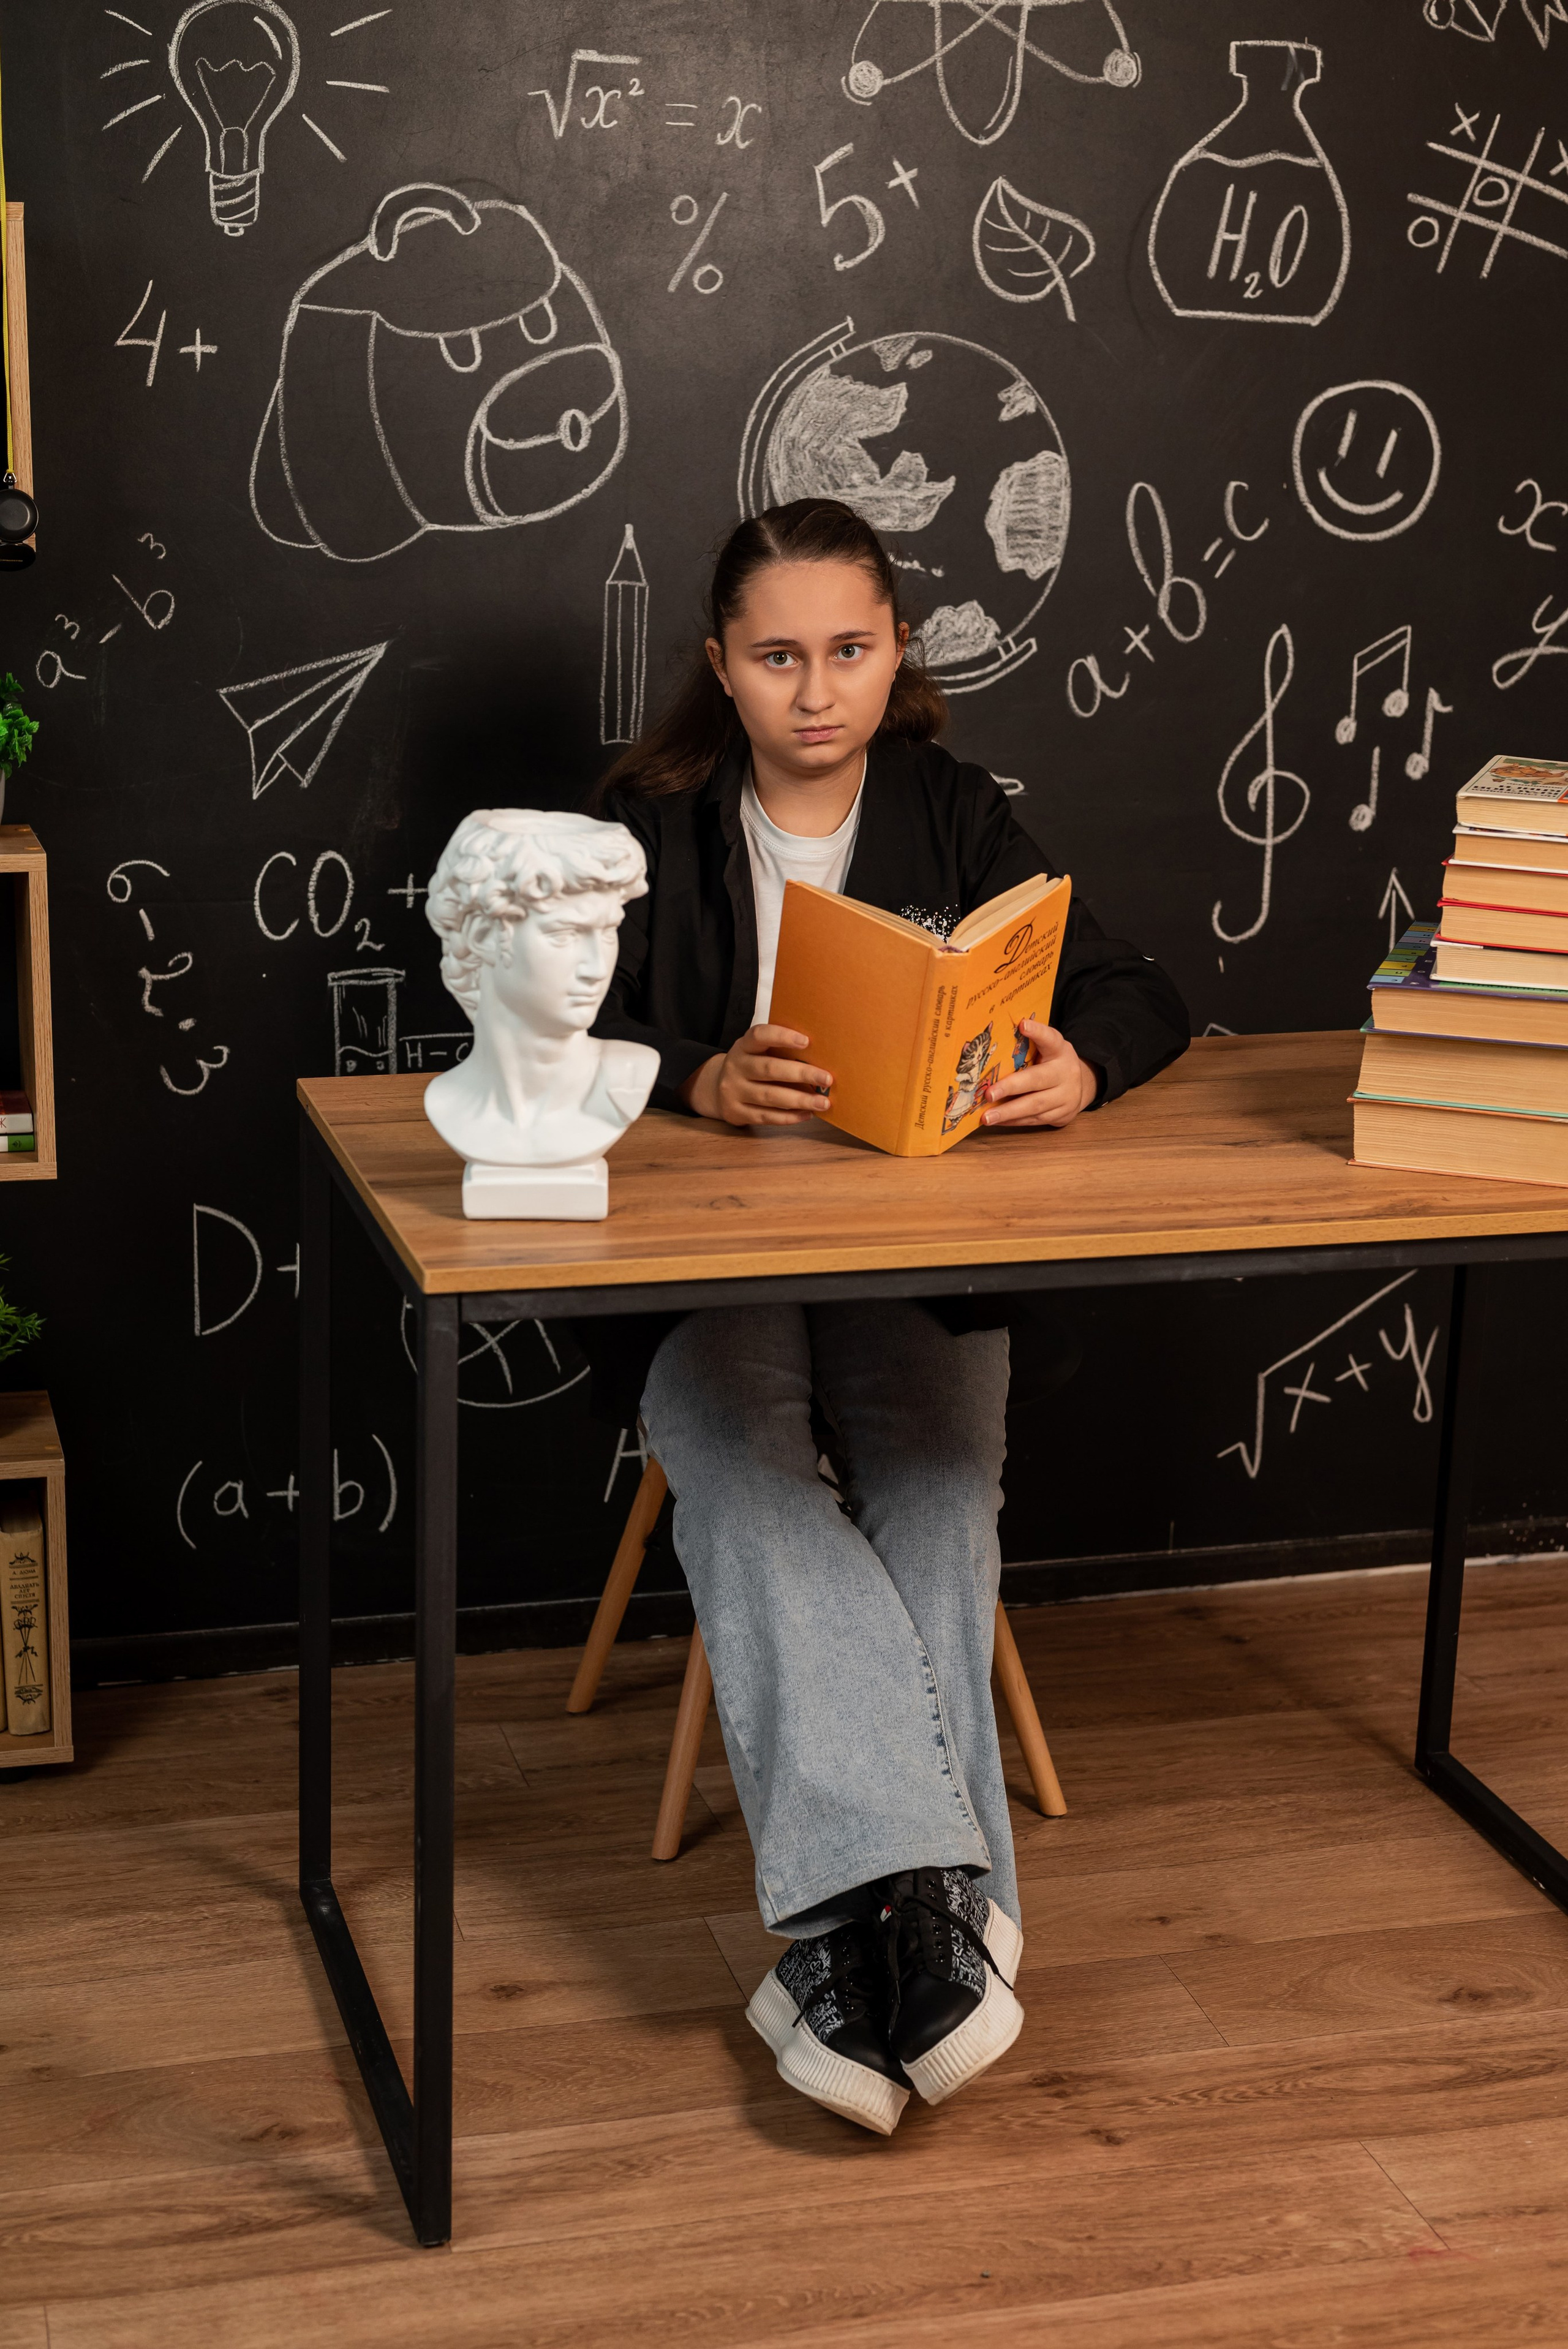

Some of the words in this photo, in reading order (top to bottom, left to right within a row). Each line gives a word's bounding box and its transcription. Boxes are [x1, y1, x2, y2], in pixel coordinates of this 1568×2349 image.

[667, 192, 729, 295] %
[966, 935, 1057, 1009] русско-английский
[993, 916, 1058, 973] Детский
[1019, 951, 1054, 981] словарь
[946, 985, 959, 1031] картинках
[989, 1005, 995, 1014] в
[1000, 962, 1052, 1006] картинках
[914, 1095, 928, 1130] Детский
[923, 1018, 940, 1094] русско-английский
[935, 985, 946, 1017] словарь
